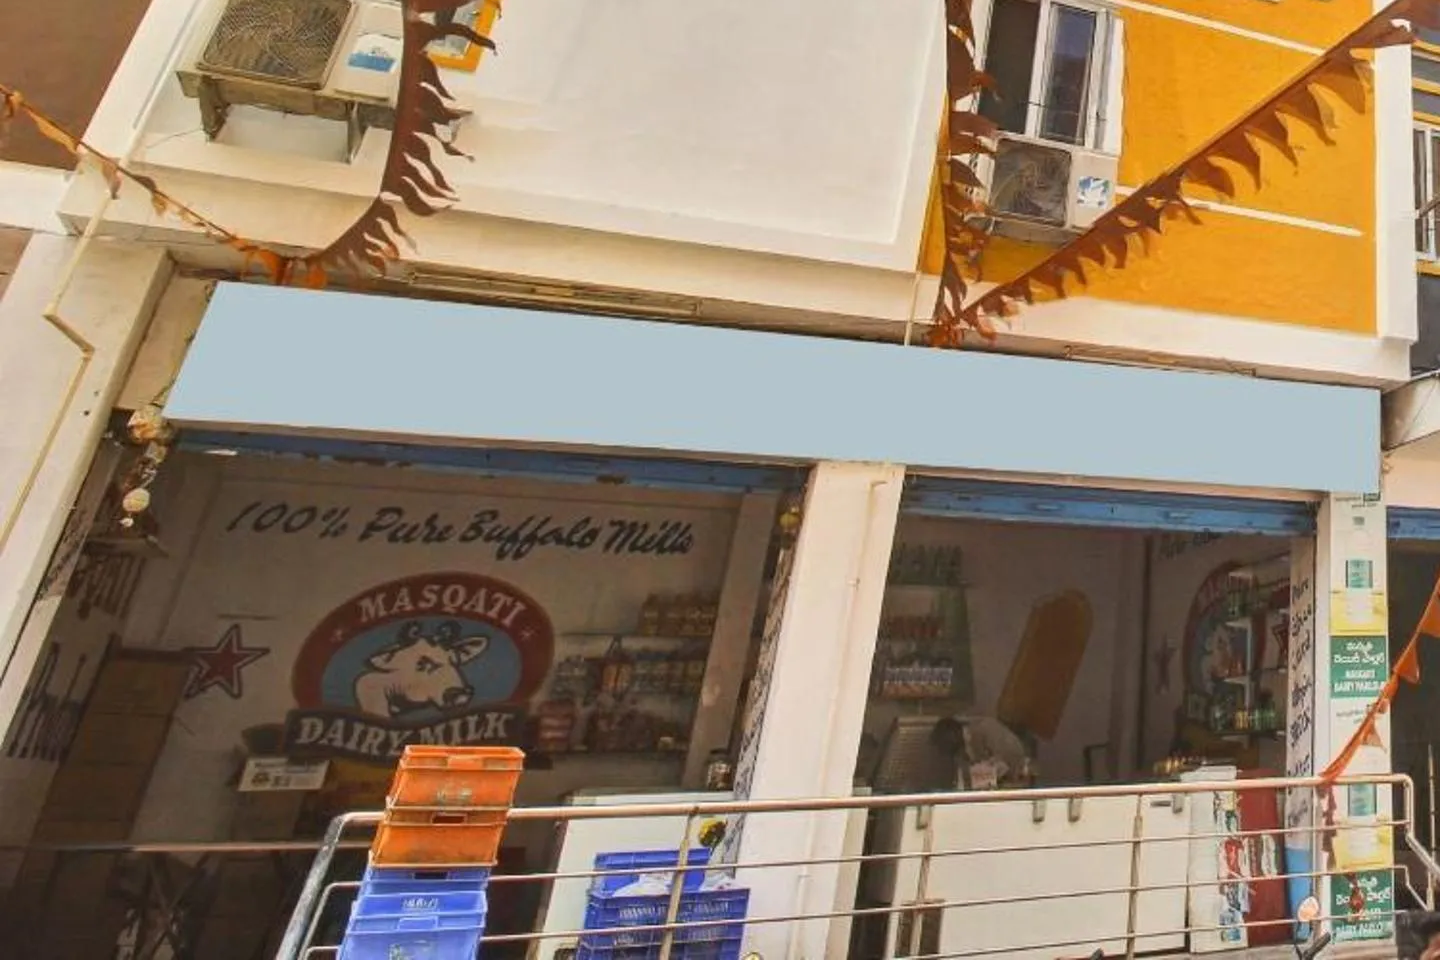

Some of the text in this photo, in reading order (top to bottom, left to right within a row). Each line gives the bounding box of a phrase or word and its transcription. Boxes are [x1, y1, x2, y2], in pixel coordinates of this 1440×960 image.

[226, 501, 351, 539] 100%
[357, 506, 455, 544] Pure
[457, 509, 600, 559] Buffalo
[356, 583, 527, 628] MASQATI
[295, 711, 514, 758] DAIRY MILK
